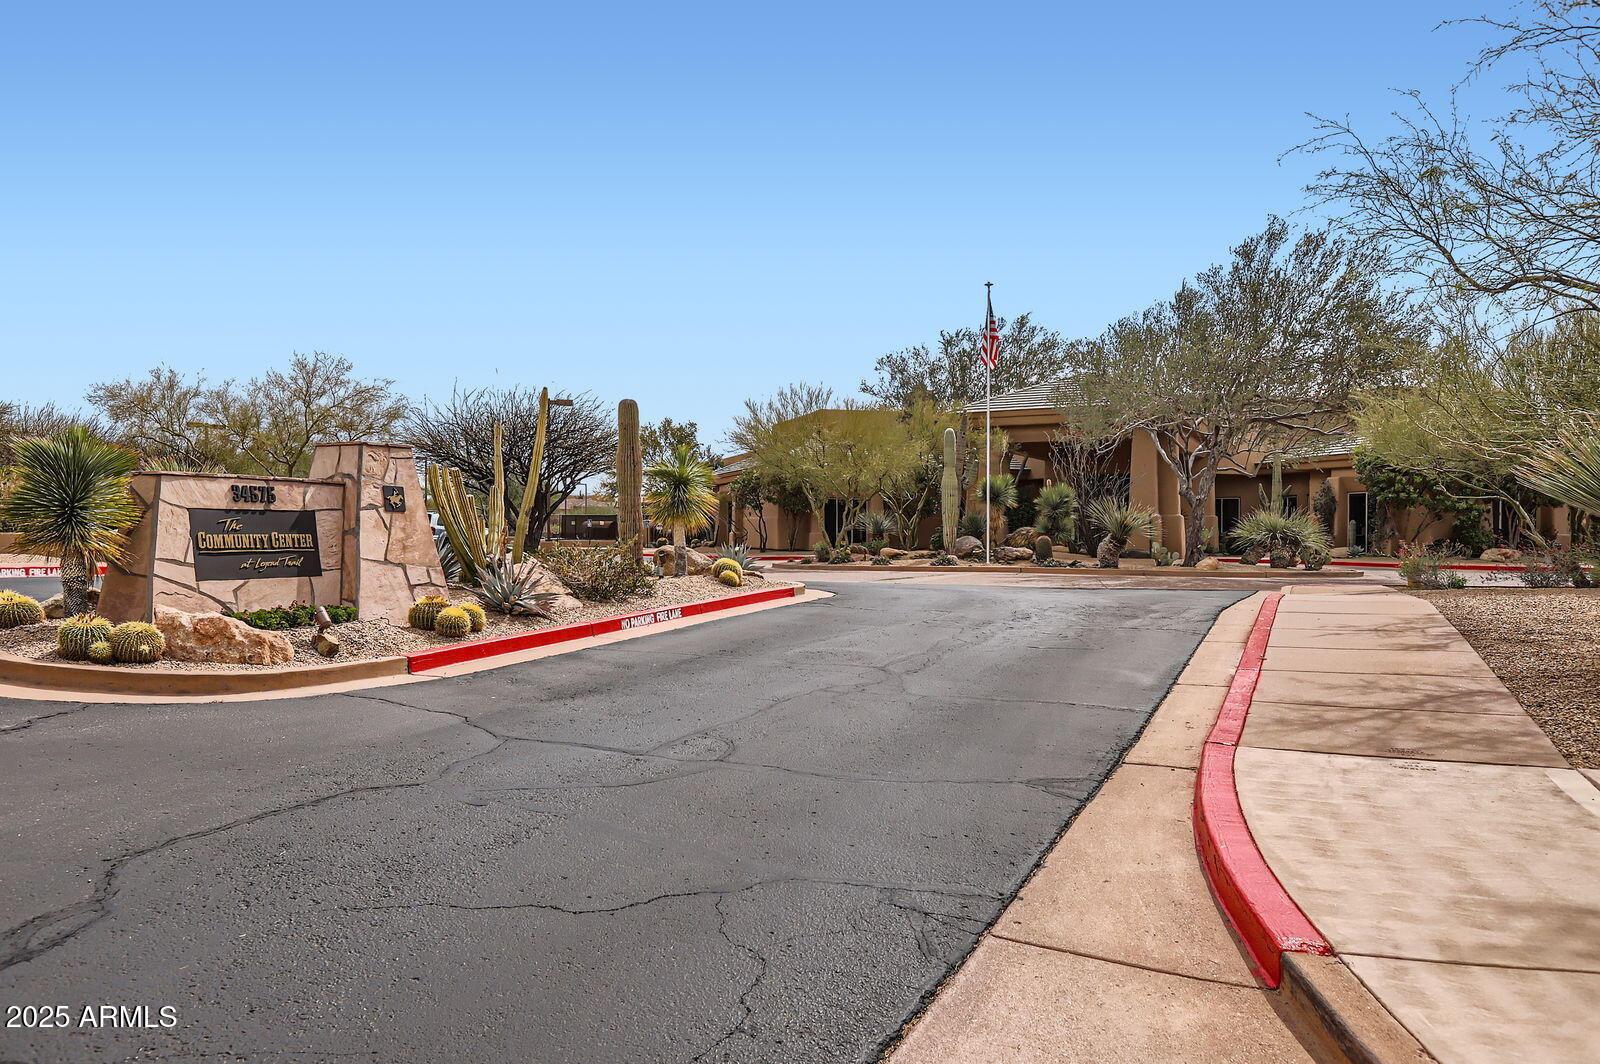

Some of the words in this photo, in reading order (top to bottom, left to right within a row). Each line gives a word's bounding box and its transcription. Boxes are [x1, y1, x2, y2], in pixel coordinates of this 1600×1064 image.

[231, 485, 276, 503] 34575
[216, 517, 243, 531] The
[197, 531, 268, 549] COMMUNITY
[271, 531, 314, 548] CENTER
[29, 568, 47, 576] FIRE
[240, 558, 255, 569] at
[255, 557, 280, 572] Legend
[281, 555, 304, 567] Trail
[621, 619, 630, 630] NO
[631, 613, 655, 628] PARKING
[656, 610, 668, 622] FIRE
[668, 608, 683, 620] LANE
